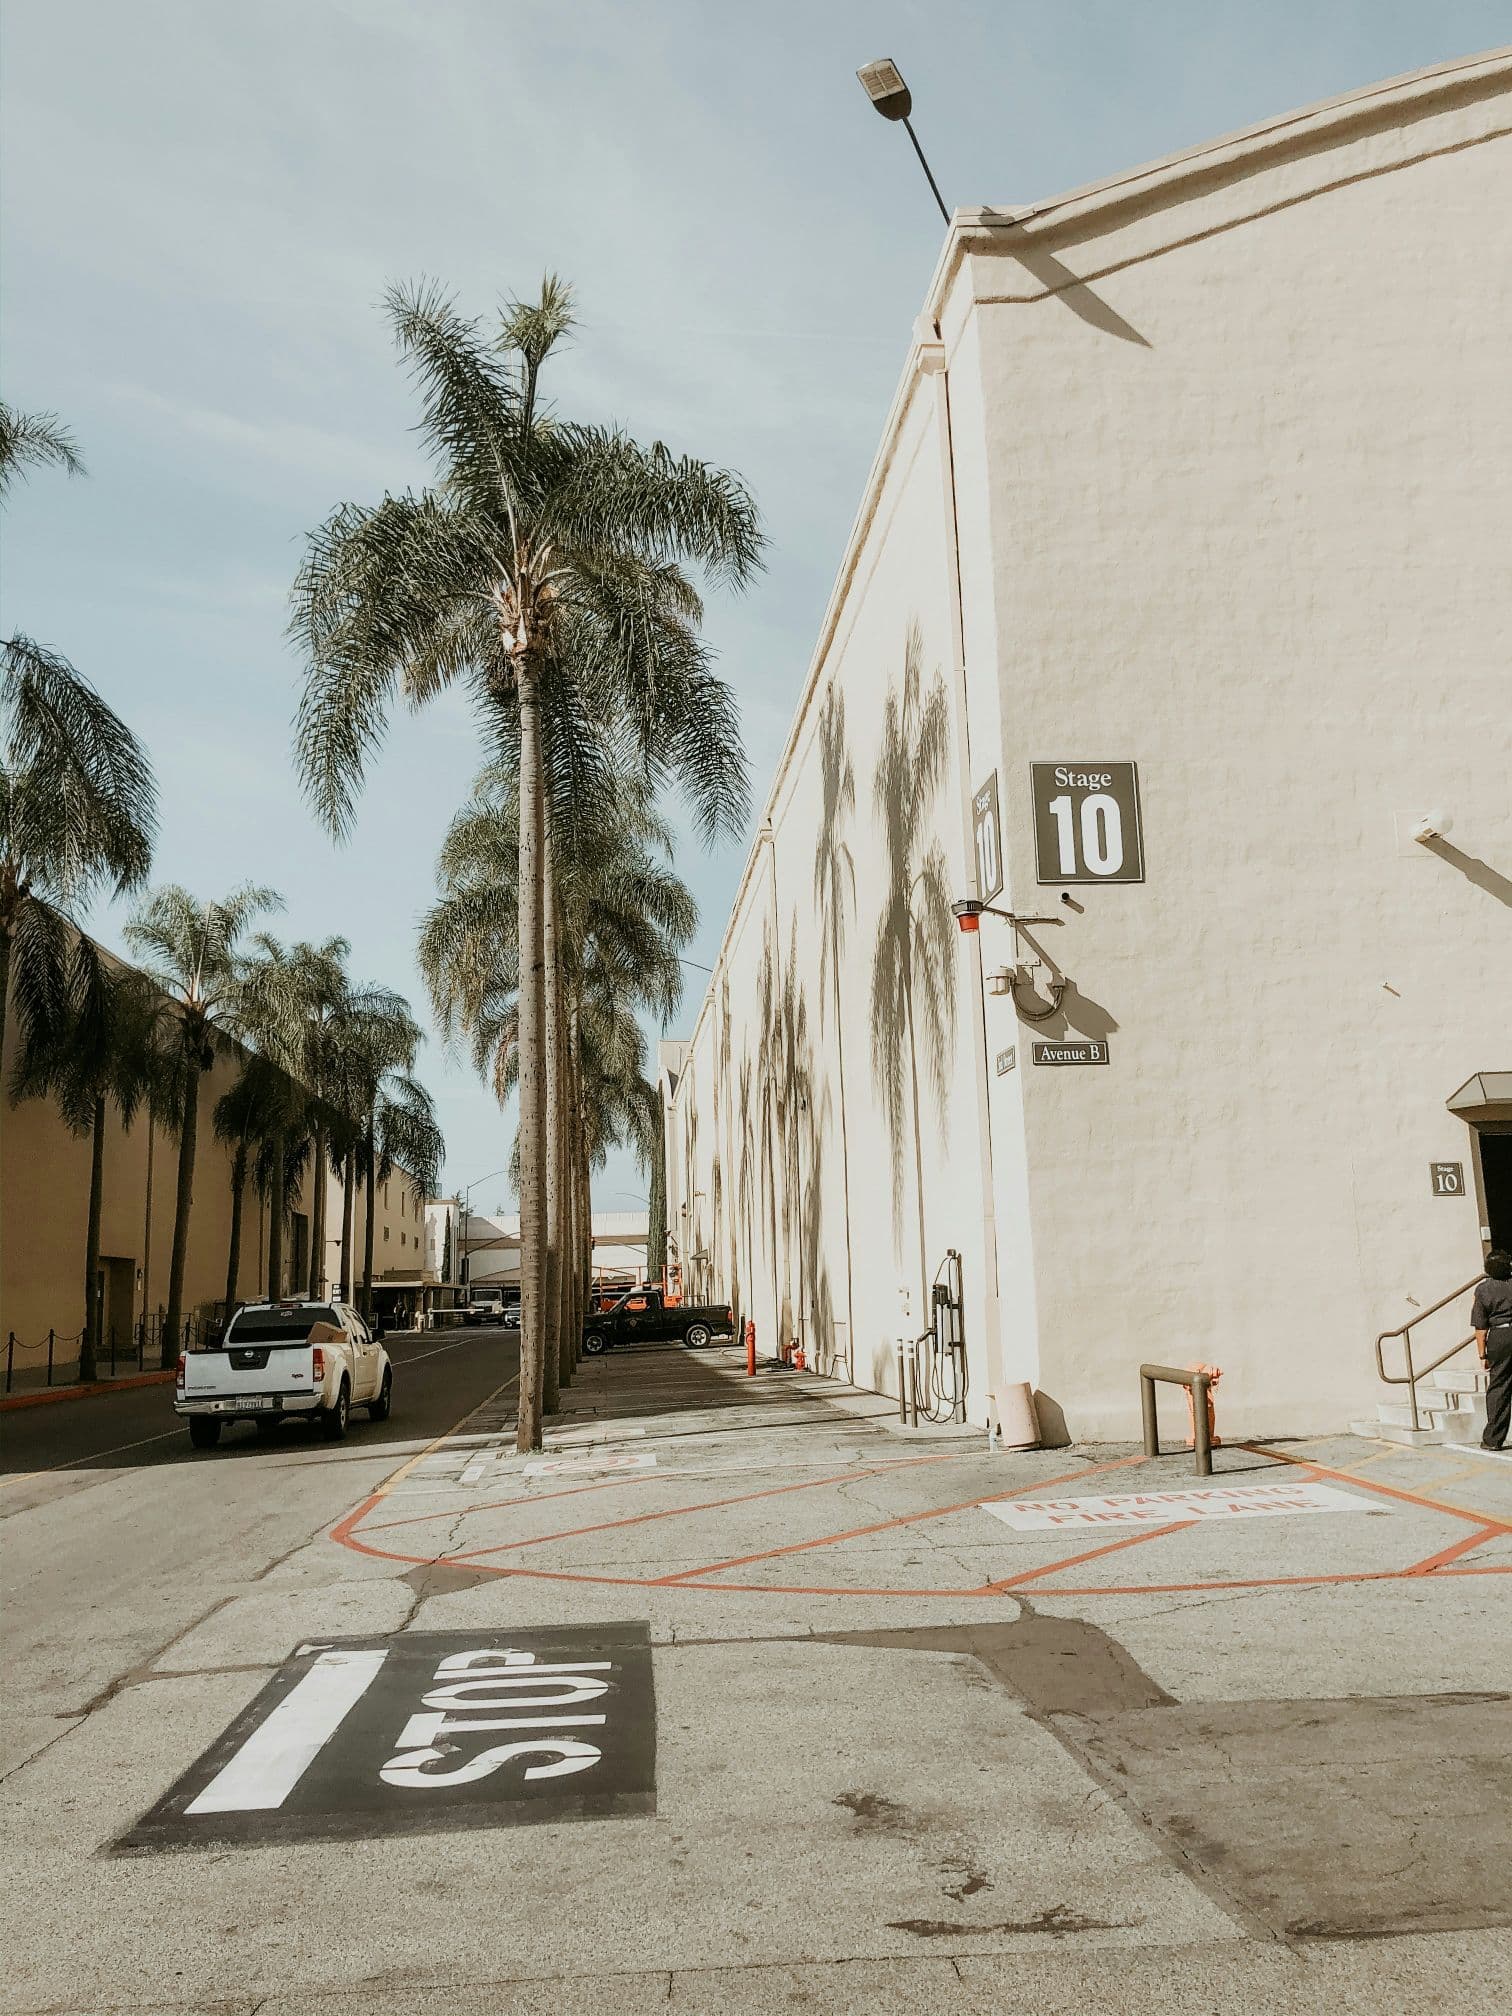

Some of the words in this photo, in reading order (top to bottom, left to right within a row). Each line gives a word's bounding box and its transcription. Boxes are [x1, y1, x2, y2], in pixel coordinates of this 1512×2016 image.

[1055, 767, 1111, 790] Stage
[1049, 794, 1124, 876] 10
[977, 811, 997, 898] 10
[1041, 1047, 1085, 1061] Avenue
[1088, 1045, 1100, 1060] B
[1437, 1174, 1457, 1192] 10
[1014, 1502, 1081, 1512] NO
[1103, 1487, 1304, 1506] PARKING
[1049, 1509, 1169, 1524] FIRE
[1187, 1498, 1328, 1515] LANE
[379, 1648, 612, 1788] STOP
